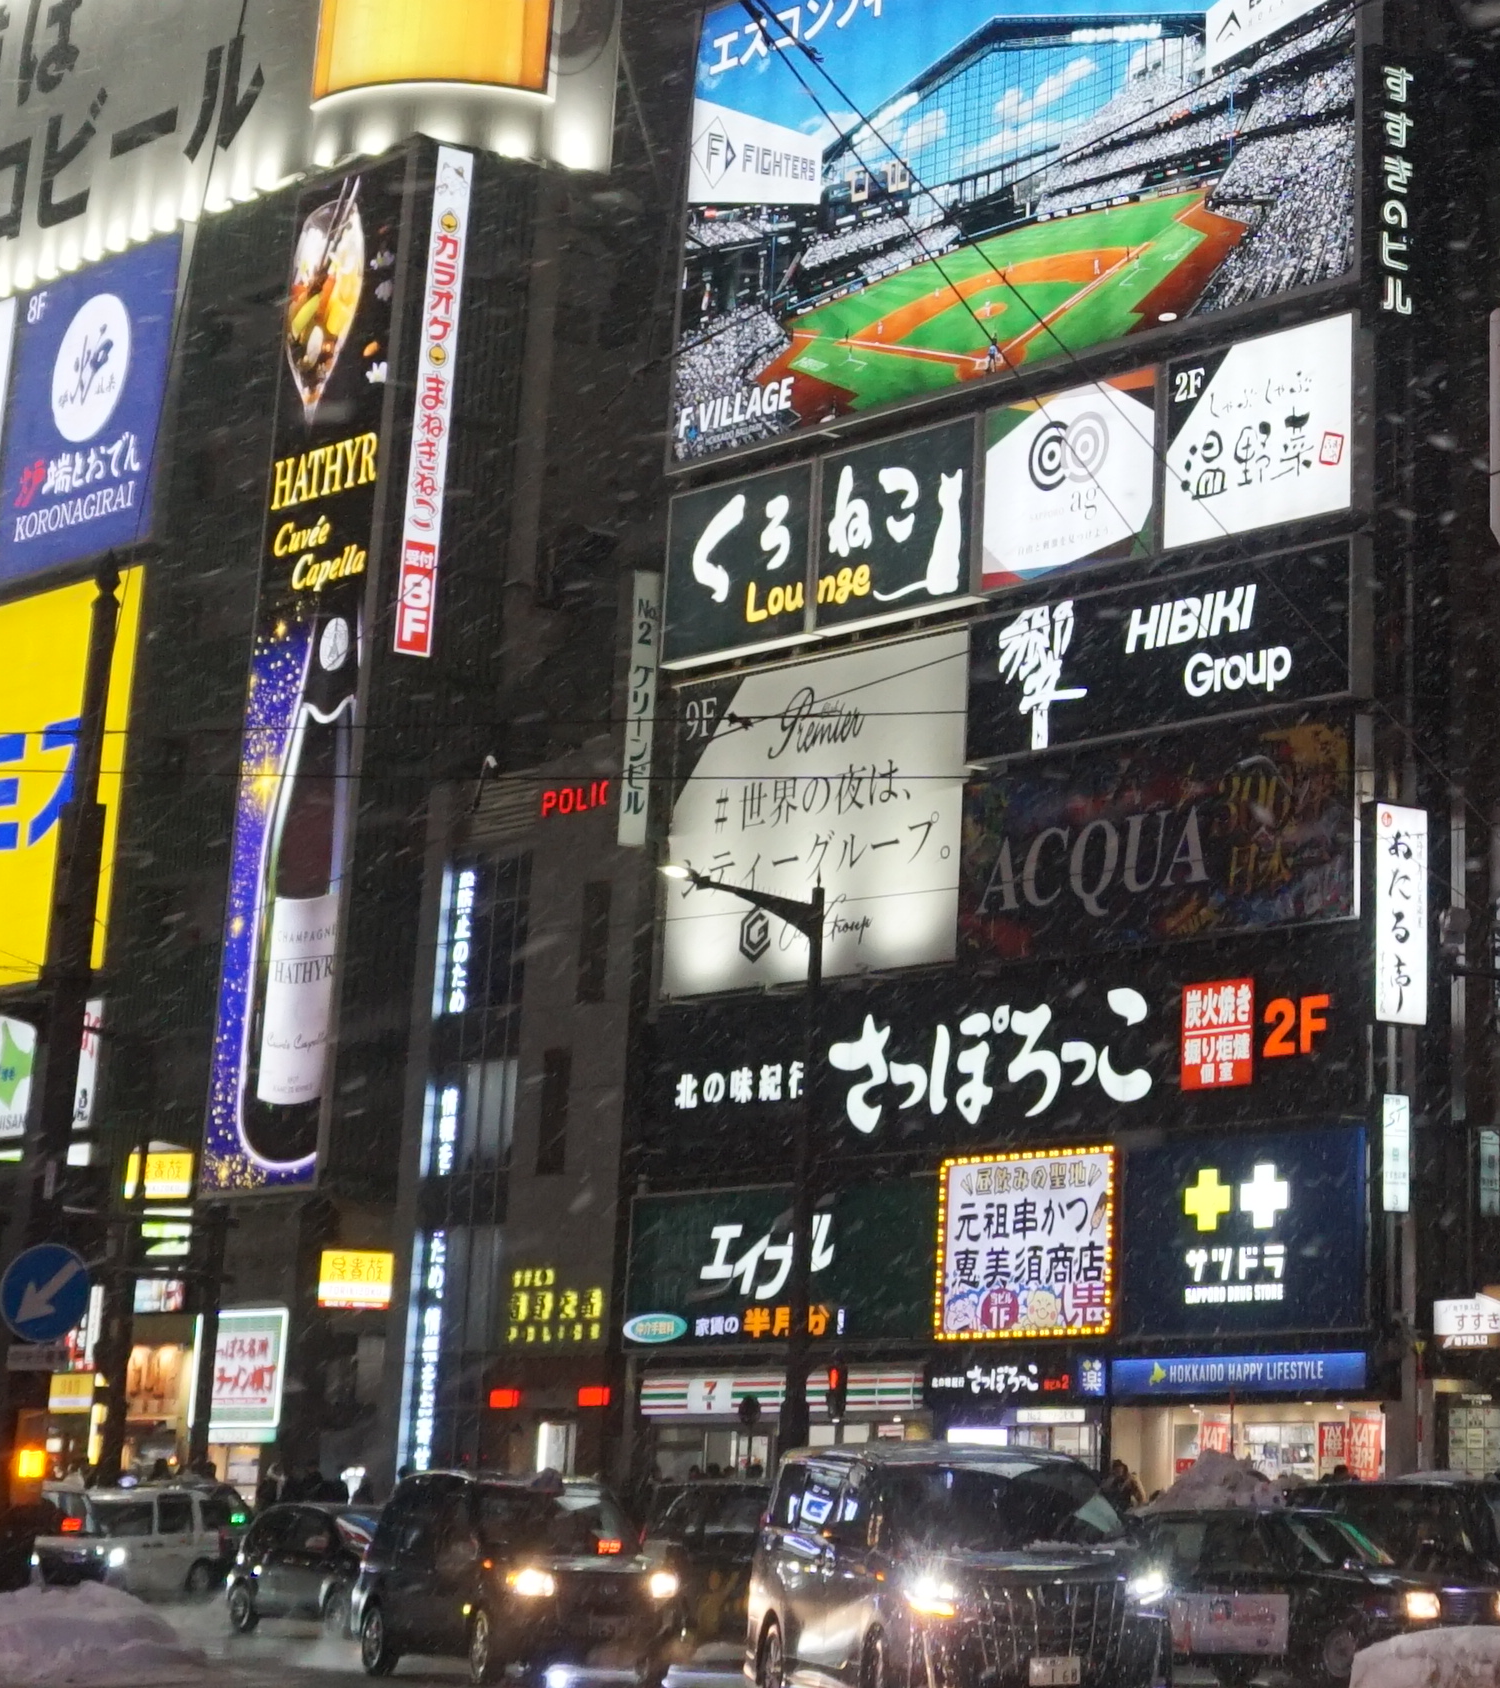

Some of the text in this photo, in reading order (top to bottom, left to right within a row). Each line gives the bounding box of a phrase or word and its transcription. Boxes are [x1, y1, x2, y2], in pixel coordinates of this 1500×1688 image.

[743, 143, 816, 181] FIGHTERS
[1379, 65, 1414, 316] すすきのビル
[27, 294, 48, 324] 8F
[411, 232, 461, 531] カラオケ まねきねこ
[699, 377, 795, 433] VILLAGE
[1174, 367, 1206, 403] 2F
[1210, 371, 1314, 419] しゃぶしゃぶ
[15, 431, 142, 508] 炉端とおでん
[271, 431, 378, 511] HATHYR
[1180, 406, 1315, 501] 温野菜
[13, 480, 137, 541] KORONAGIRAI
[1070, 486, 1098, 521] ag
[274, 516, 330, 558] Cuvée
[693, 464, 919, 604] くろねこ
[291, 544, 367, 591] Capella
[400, 548, 435, 643] 受付 8F
[746, 562, 871, 624] Lounge
[1125, 584, 1258, 654] HIBIKI
[1184, 644, 1293, 698] Group
[623, 664, 654, 815] グリーンビル
[686, 697, 717, 742] 9F
[768, 686, 865, 759] Premier
[541, 779, 609, 817] POLIC
[975, 805, 1210, 917] ACQUA
[1387, 830, 1413, 1015] おたる亭
[274, 958, 336, 985] HATHYR
[1184, 984, 1330, 1058] 炭火焼き 2F
[828, 987, 1153, 1134] さっぽろっこ
[1199, 1061, 1235, 1085] 個室
[976, 1162, 1088, 1196] 昼飲みの聖地
[954, 1197, 1090, 1242] 元祖串かつ
[952, 1241, 1105, 1289] 恵美須商店
[1185, 1244, 1286, 1283] サツドラ
[989, 1306, 1011, 1330] 1F
[1184, 1283, 1284, 1305] SAPPORO DRUG STORE
[216, 1334, 270, 1359] っぽろ名所
[966, 1365, 1040, 1395] さっぽろっこ
[1169, 1360, 1325, 1384] HOKKAIDO HAPPY LIFESTYLE
[1322, 1425, 1343, 1439] TAX
